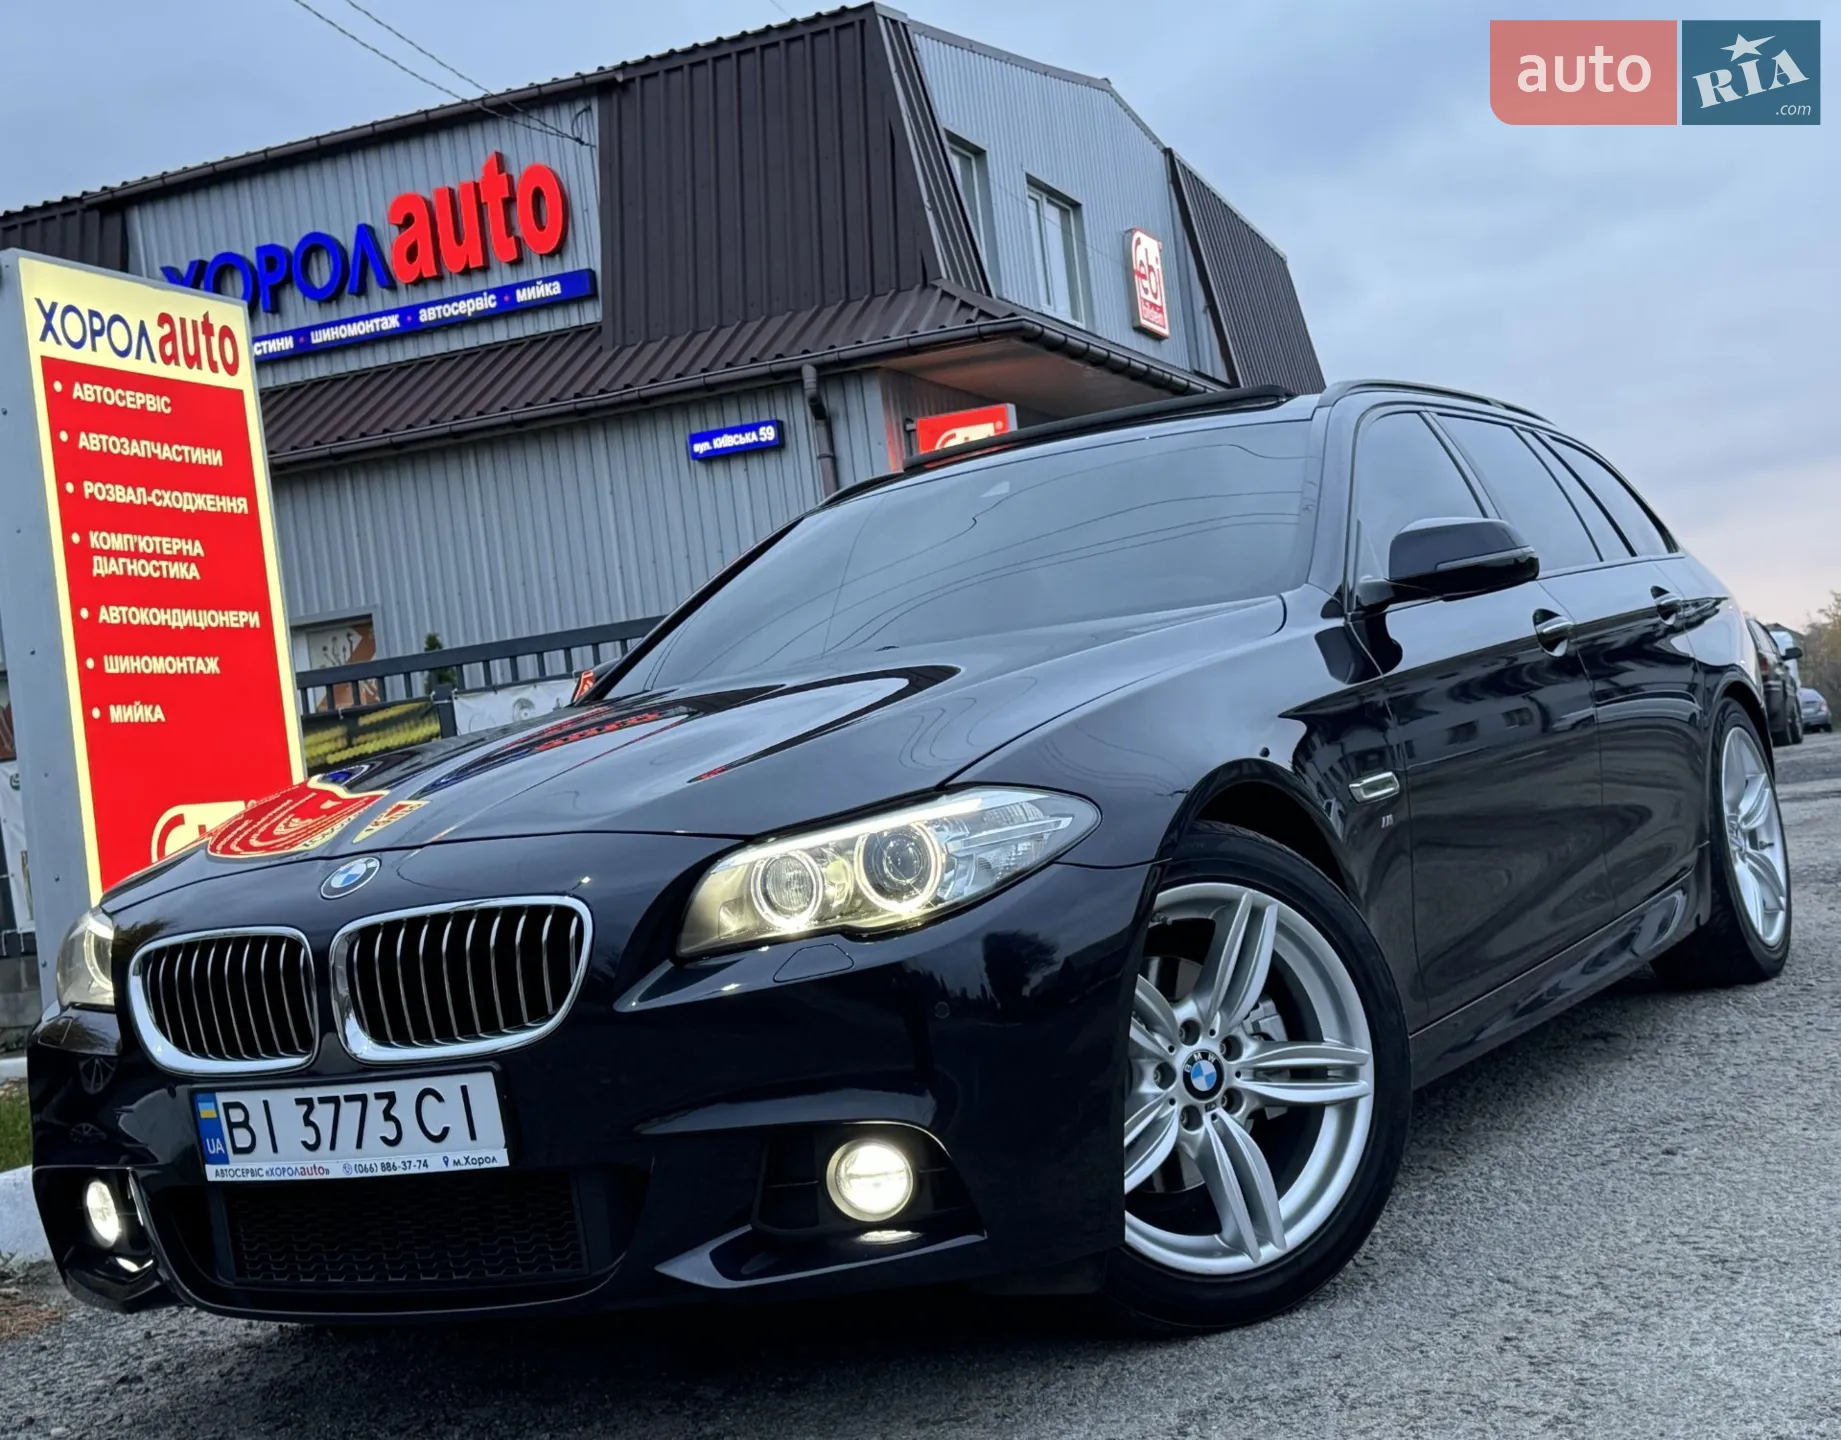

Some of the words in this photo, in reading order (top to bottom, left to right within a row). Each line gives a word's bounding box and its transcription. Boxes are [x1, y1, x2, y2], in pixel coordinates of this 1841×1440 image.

[252, 335, 295, 357] стини
[310, 313, 401, 344] шиномонтаж
[418, 291, 498, 323] автосервіс
[515, 279, 562, 304] мийка
[72, 381, 172, 414] АВТОСЕРВІС
[78, 431, 223, 467] АВТОЗАПЧАСТИНИ
[713, 431, 758, 449] КИЇВСЬКА
[759, 425, 776, 442] 59
[83, 480, 249, 514] РОЗВАЛ-СХОДЖЕННЯ
[89, 530, 205, 558] КОМП'ЮТЕРНА
[92, 555, 201, 581] ДІАГНОСТИКА
[98, 605, 261, 631] АВТОКОНДИЦІОНЕРИ
[103, 655, 220, 675] ШИНОМОНТАЖ
[109, 701, 166, 723] МИЙКА
[294, 1091, 403, 1152] 3773
[207, 1138, 225, 1155] UA
[215, 1167, 264, 1178] АВТОСЕРВІС
[354, 1162, 378, 1174] (066)
[380, 1159, 429, 1172] 886-37-74
